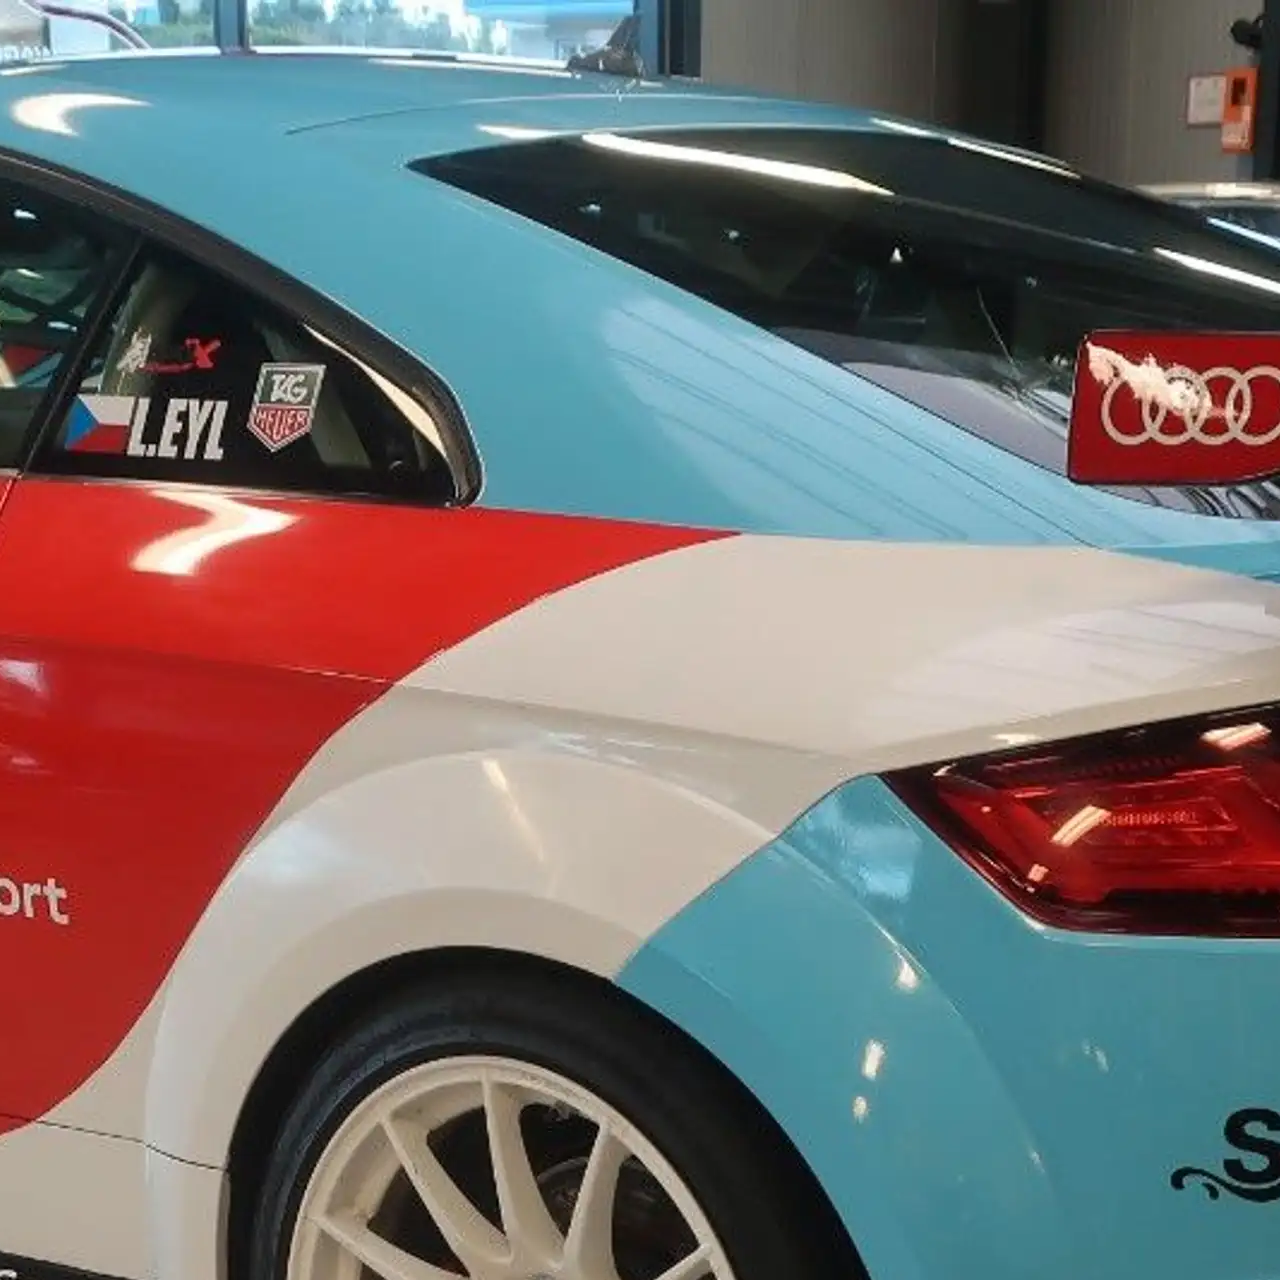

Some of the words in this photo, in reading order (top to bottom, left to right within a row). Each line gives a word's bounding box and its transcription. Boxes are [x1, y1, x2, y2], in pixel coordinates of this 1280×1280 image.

[269, 373, 308, 403] TAG
[126, 397, 228, 460] L.EYL
[255, 407, 309, 441] HEUER
